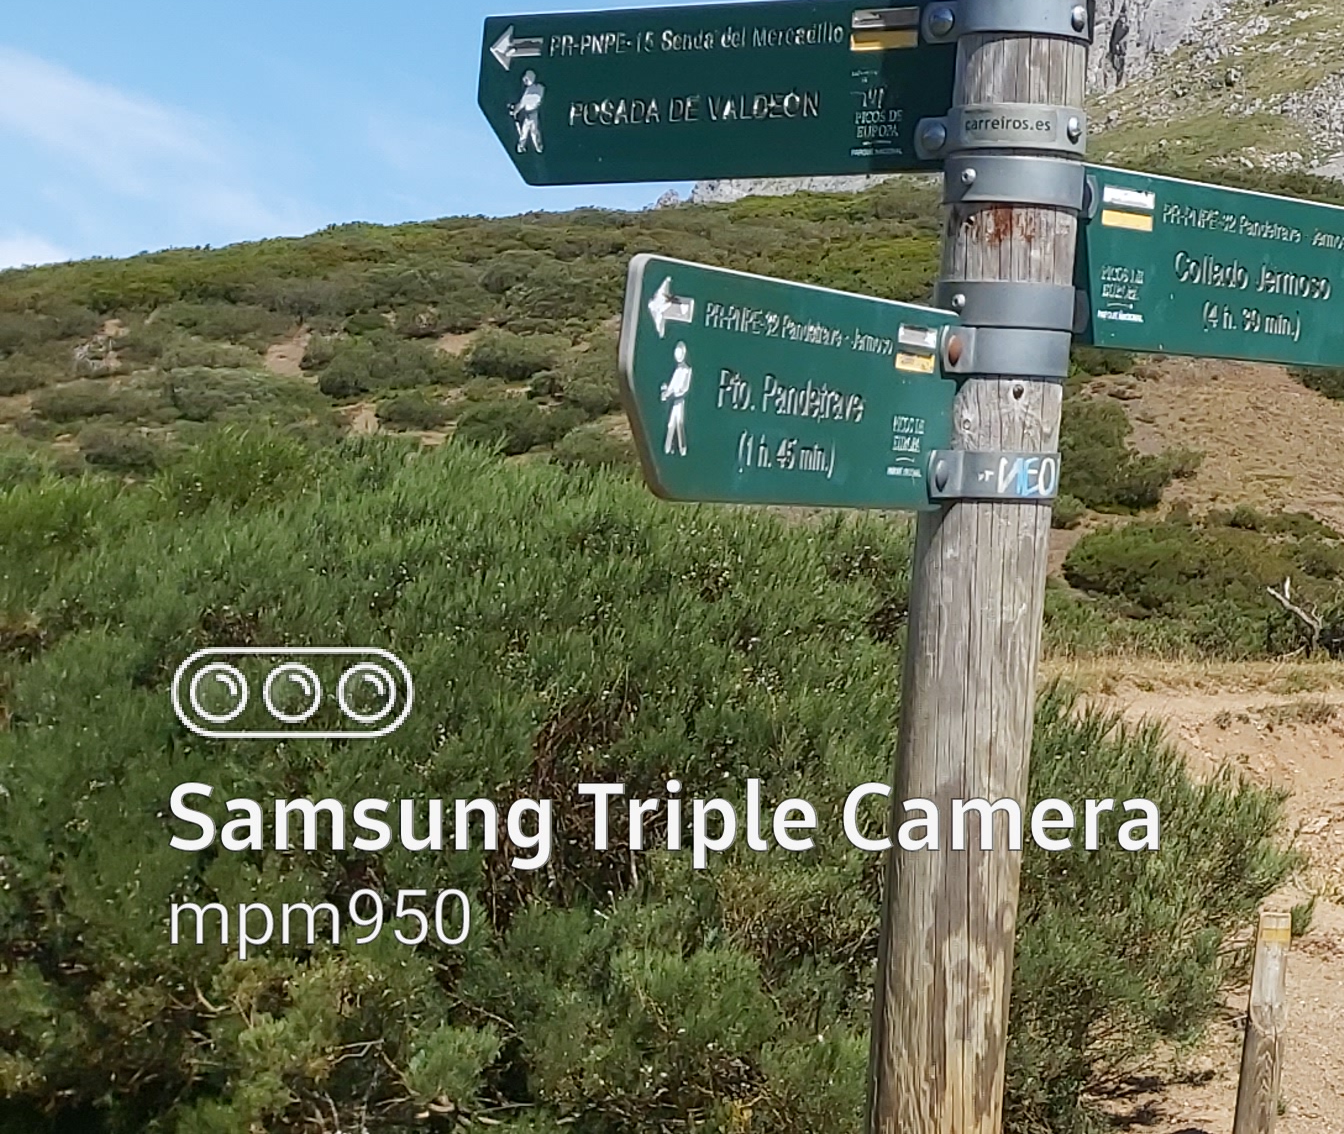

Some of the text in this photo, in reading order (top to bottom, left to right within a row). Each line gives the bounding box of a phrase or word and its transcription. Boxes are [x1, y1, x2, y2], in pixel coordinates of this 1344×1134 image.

[549, 20, 844, 57] PR-PNPE-15 Senda del Mercadillo
[569, 97, 660, 126] POSADA
[669, 94, 700, 123] DE
[855, 110, 886, 125] PICOS
[965, 115, 1051, 132] carreiros.es
[1175, 252, 1332, 301] Collado Jermoso
[1203, 301, 1219, 333] (4
[1223, 305, 1237, 330] h.
[1264, 312, 1301, 342] min.)
[717, 368, 865, 424] Pto. Pandetrave
[738, 429, 836, 480] (1 h. 45 min.)
